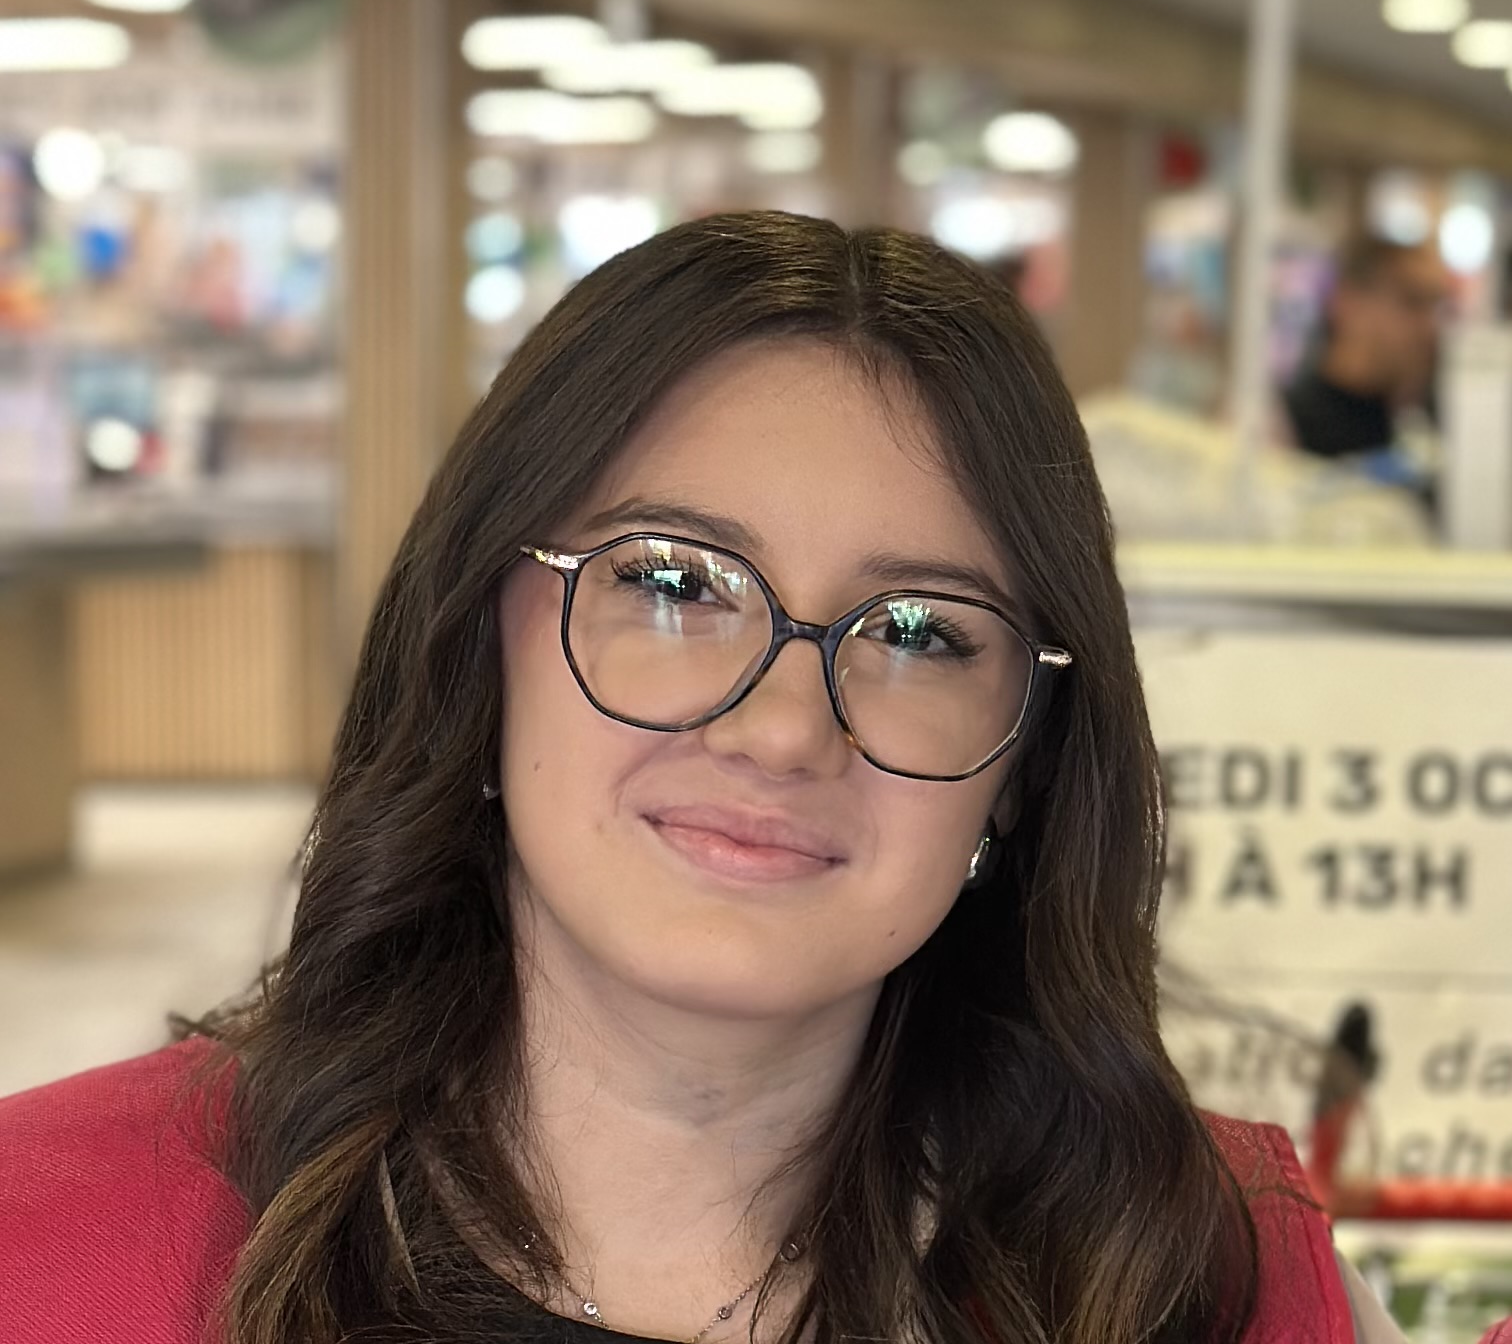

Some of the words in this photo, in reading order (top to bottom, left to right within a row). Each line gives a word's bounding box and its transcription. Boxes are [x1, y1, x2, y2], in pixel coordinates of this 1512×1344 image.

[1326, 748, 1384, 816] 3
[1215, 821, 1283, 908] À
[1302, 841, 1471, 912] 13H
